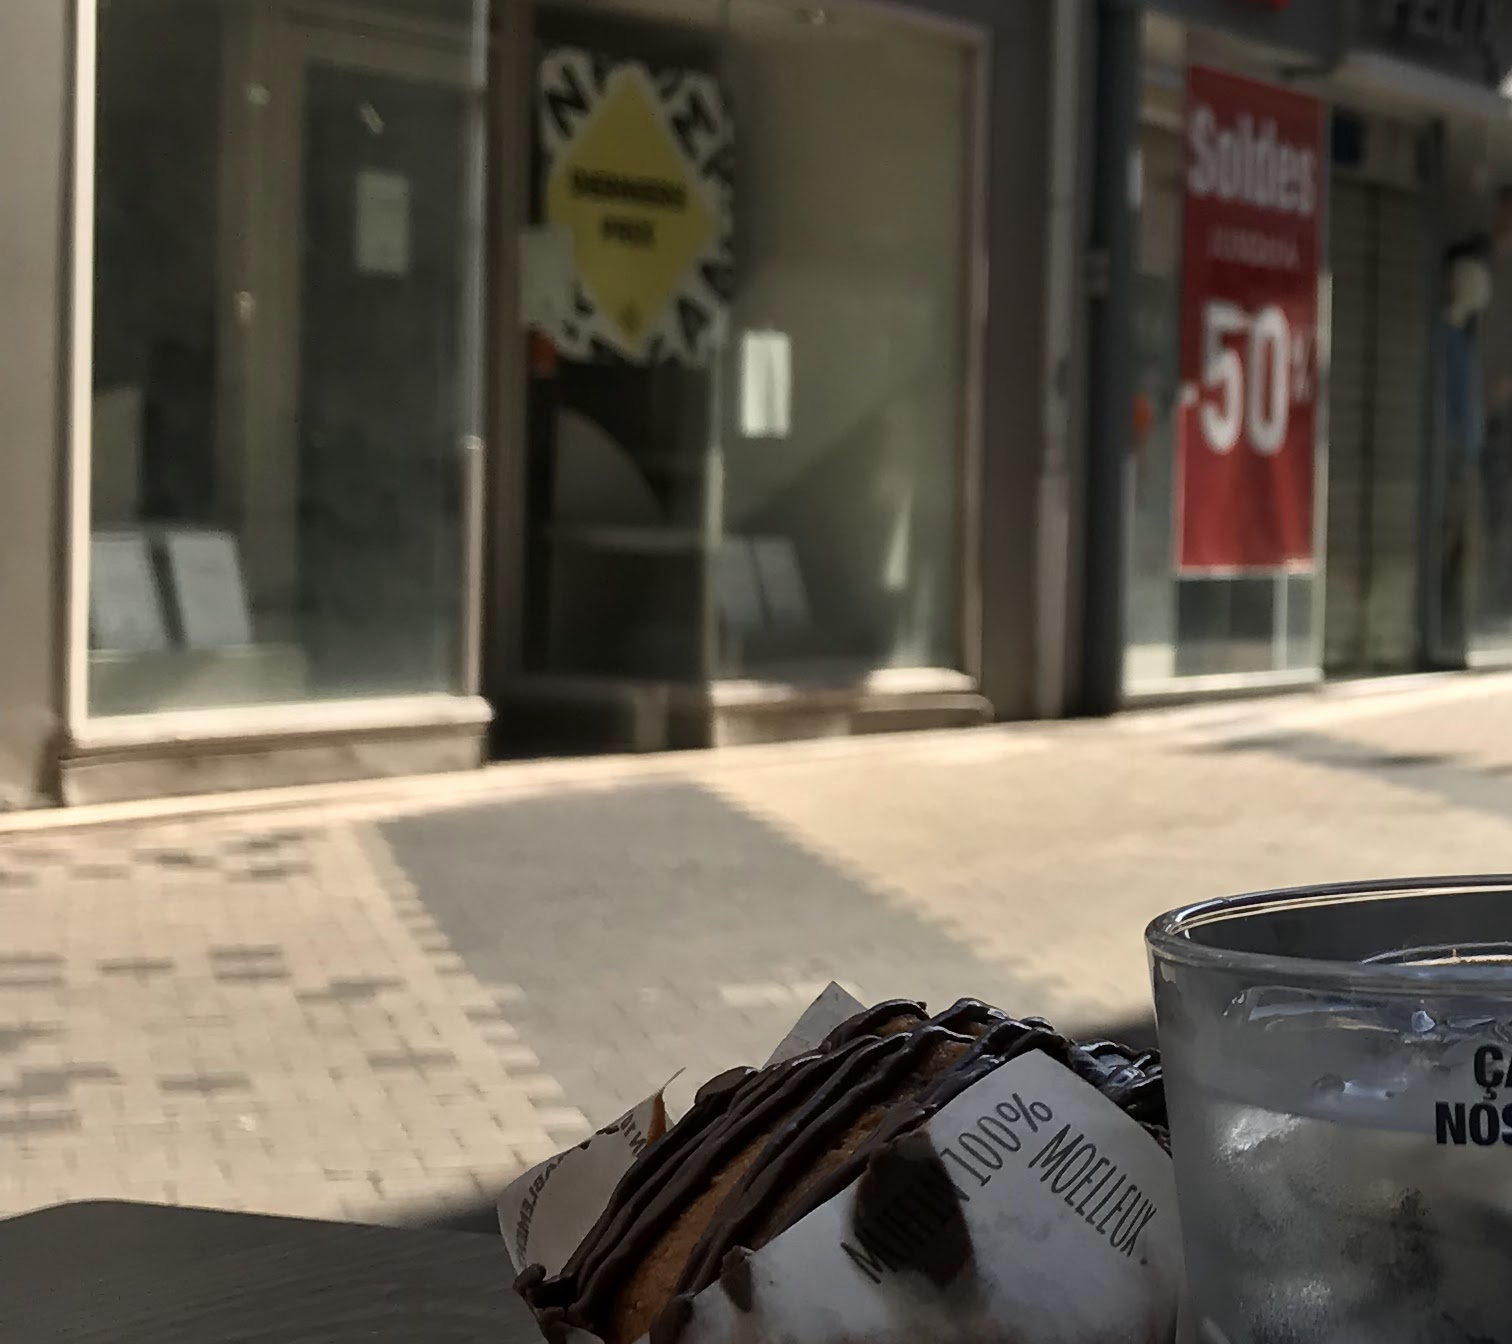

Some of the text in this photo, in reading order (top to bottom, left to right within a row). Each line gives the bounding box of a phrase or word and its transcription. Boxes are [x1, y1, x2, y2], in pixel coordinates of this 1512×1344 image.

[1186, 102, 1316, 218] Soldes
[940, 1092, 1053, 1187] 100%
[1027, 1123, 1158, 1257] MOELLEUX
